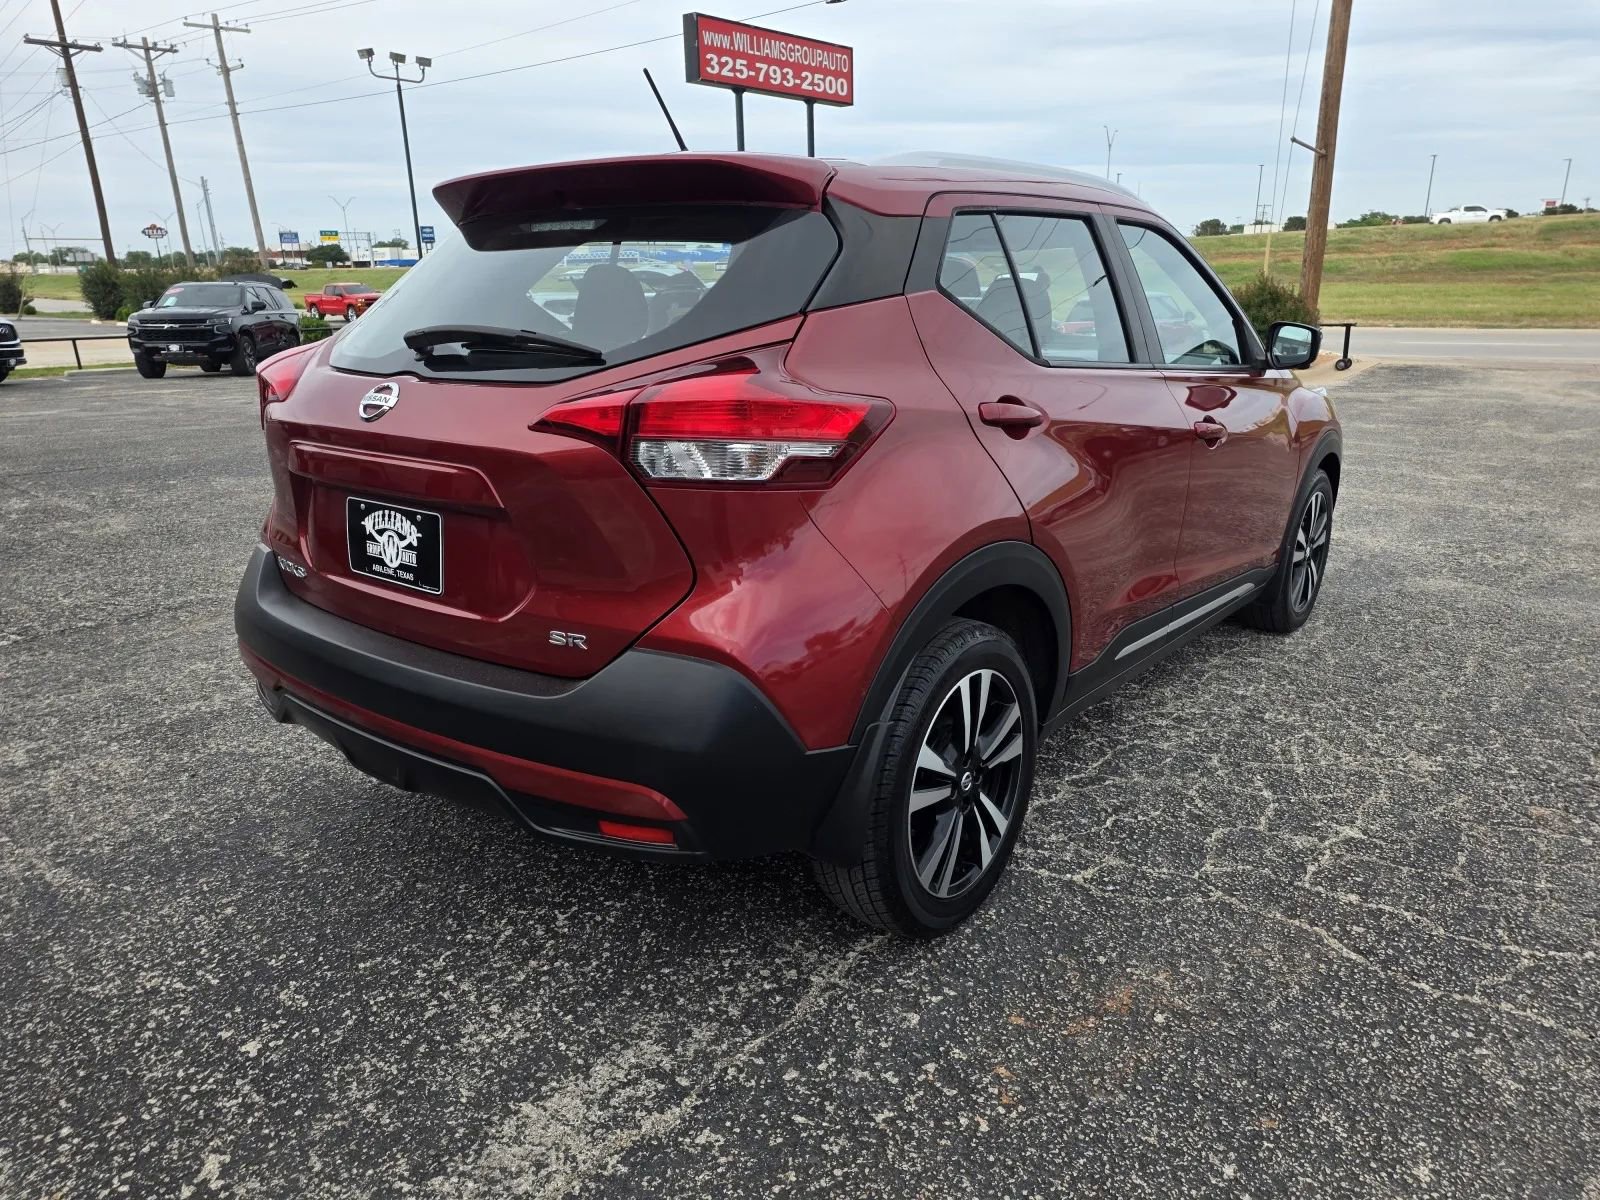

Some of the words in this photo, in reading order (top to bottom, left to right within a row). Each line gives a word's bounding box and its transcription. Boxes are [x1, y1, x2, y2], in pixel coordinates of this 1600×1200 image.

[702, 30, 849, 73] www.WILLIAMSGROUPAUTO
[705, 53, 848, 96] 325-793-2500
[364, 510, 418, 547] WILLIAMS
[401, 551, 417, 564] AUTO
[396, 569, 414, 581] TEXAS
[548, 630, 588, 650] SR
